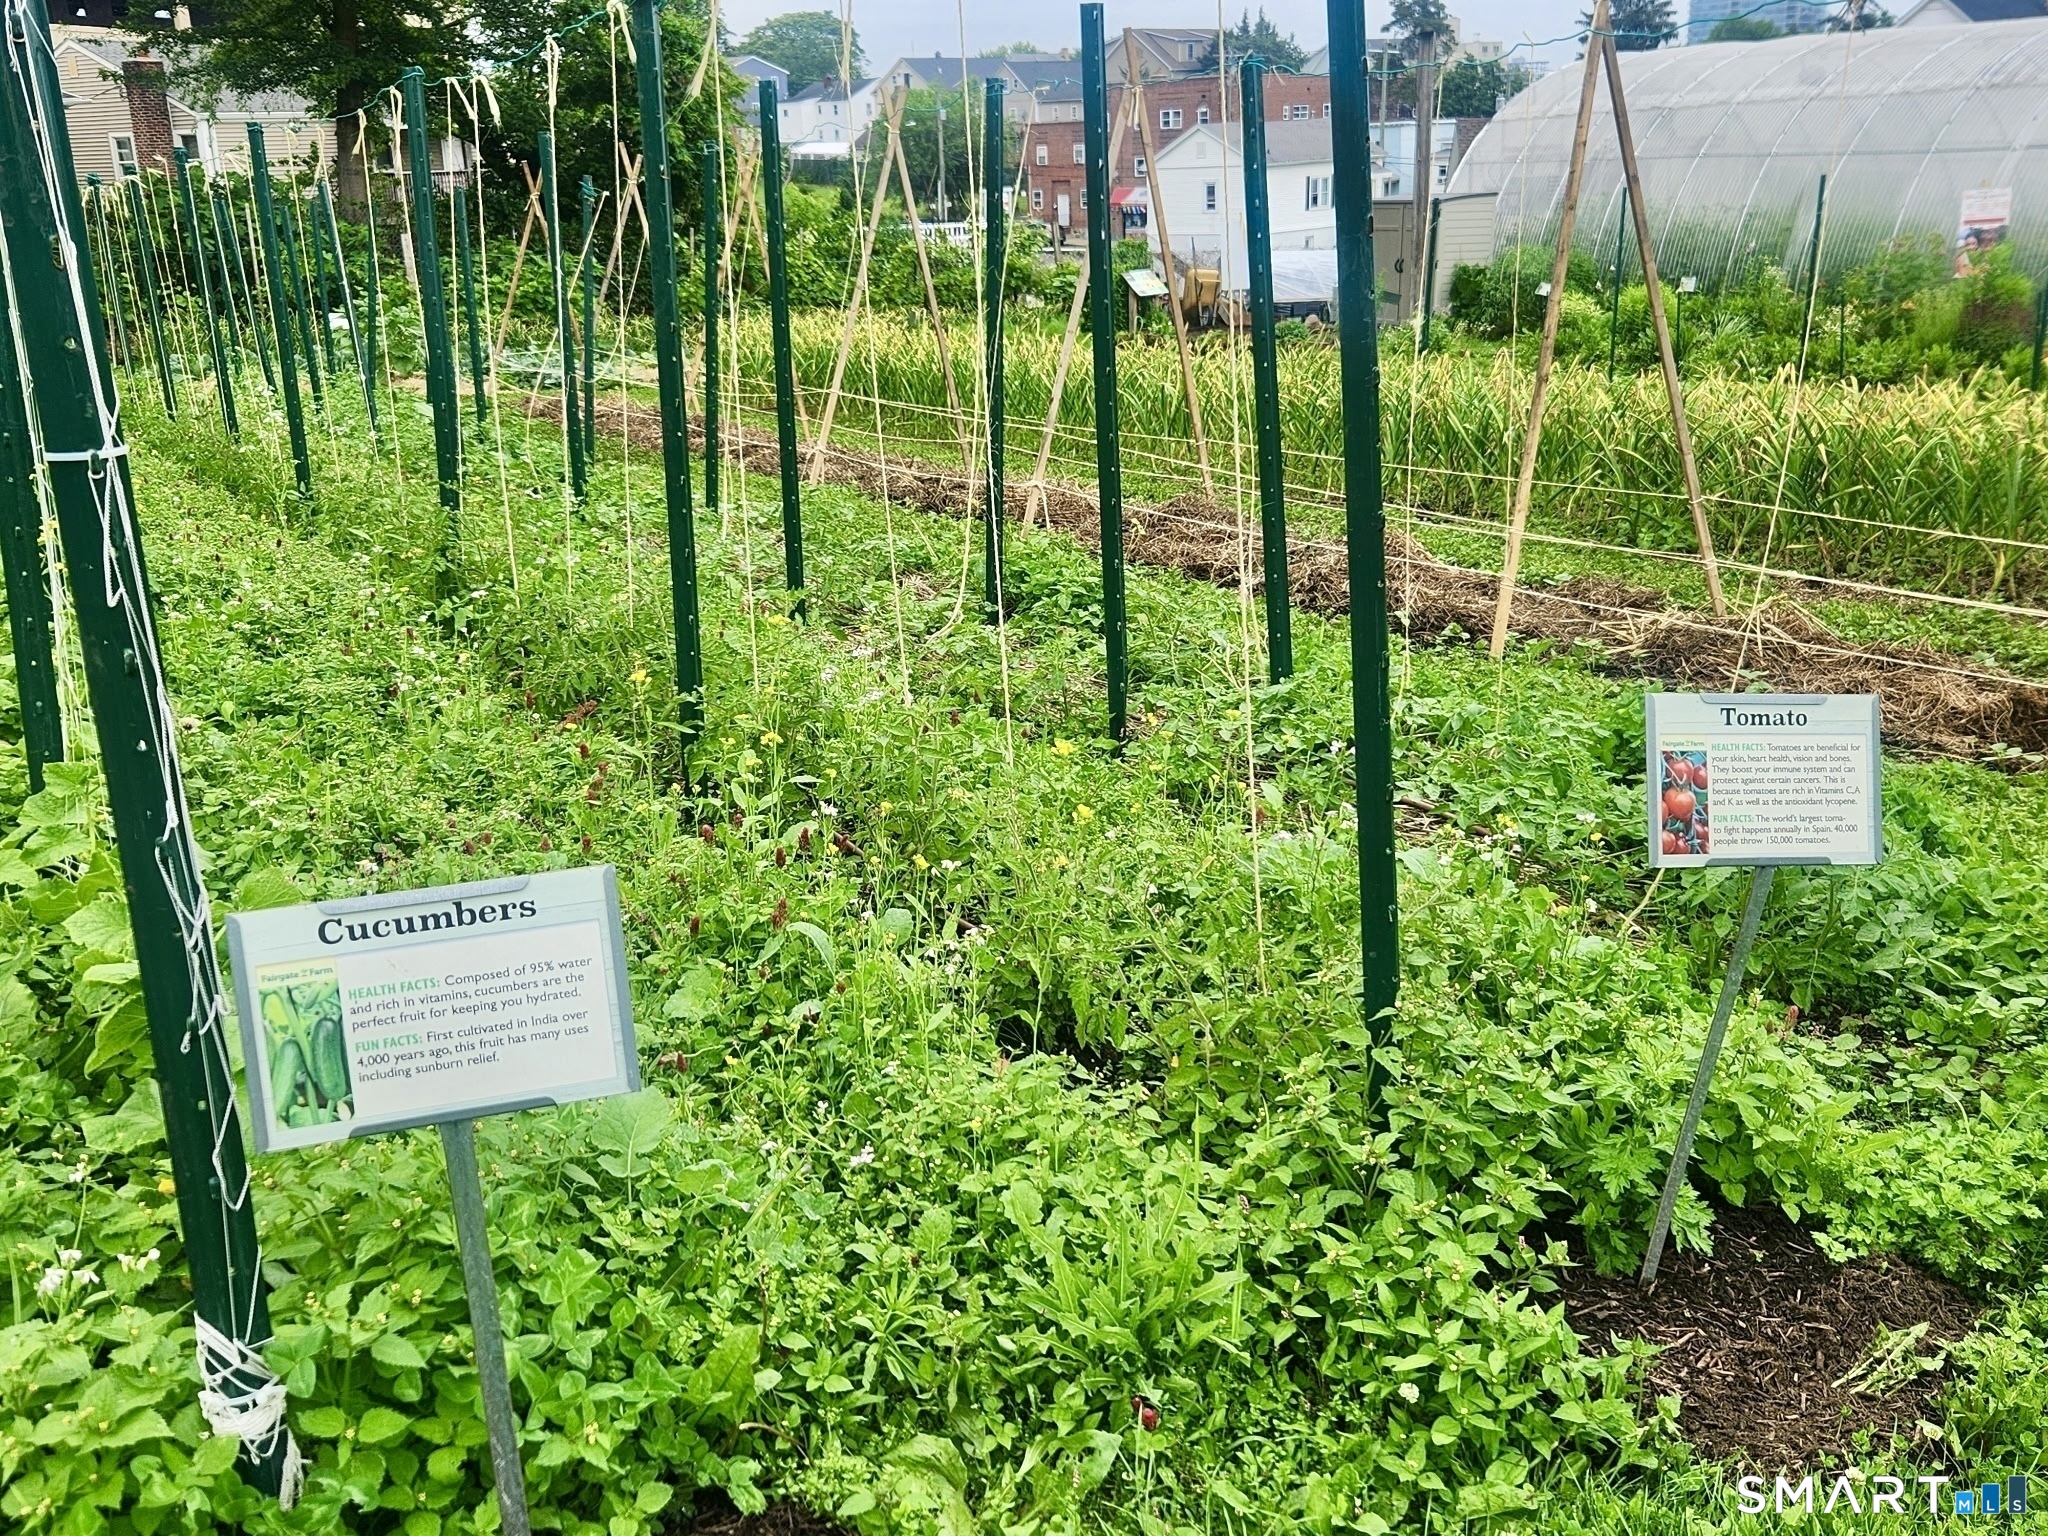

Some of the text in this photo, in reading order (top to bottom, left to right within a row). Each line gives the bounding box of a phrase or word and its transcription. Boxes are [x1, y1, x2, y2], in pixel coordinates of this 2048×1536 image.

[1720, 708, 1808, 726] Tomato
[1767, 743, 1801, 751] Tomatoes
[1816, 743, 1848, 752] beneficial
[1850, 743, 1861, 751] for
[1730, 754, 1746, 763] skin,
[1768, 754, 1792, 762] health,
[1793, 754, 1813, 762] vision
[1814, 754, 1828, 762] and
[1830, 754, 1852, 762] bones.
[1712, 765, 1730, 774] They
[1732, 765, 1753, 773] boost
[1773, 765, 1801, 773] immune
[1803, 766, 1827, 775] system
[1829, 765, 1842, 773] and
[1713, 777, 1739, 785] protect
[1741, 776, 1764, 786] against
[1824, 776, 1838, 784] This
[1825, 797, 1858, 807] lycopene.
[1730, 814, 1754, 822] FACTS:
[1800, 814, 1822, 824] largest
[1724, 826, 1740, 836] fight
[1742, 826, 1771, 835] happens
[1774, 825, 1801, 835] annually
[1812, 825, 1832, 834] Spain.
[1834, 824, 1857, 833] 40,000
[1714, 837, 1738, 846] people
[1766, 836, 1793, 844] 150,000
[318, 900, 536, 944] Cucumbers
[261, 972, 299, 982] Fairgate
[348, 957, 592, 1000] HEALTH FACTS: Composed of 95% water
[350, 973, 584, 1014] and rich in vitamins, cucumbers are the
[352, 988, 581, 1032] perfect fruit for keeping you hydrated.
[355, 1010, 588, 1052] FUN FACTS: First cultivated in India over
[357, 1024, 588, 1068] 4,000 years ago, this fruit has many uses
[359, 1052, 500, 1082] including sunburn relief.
